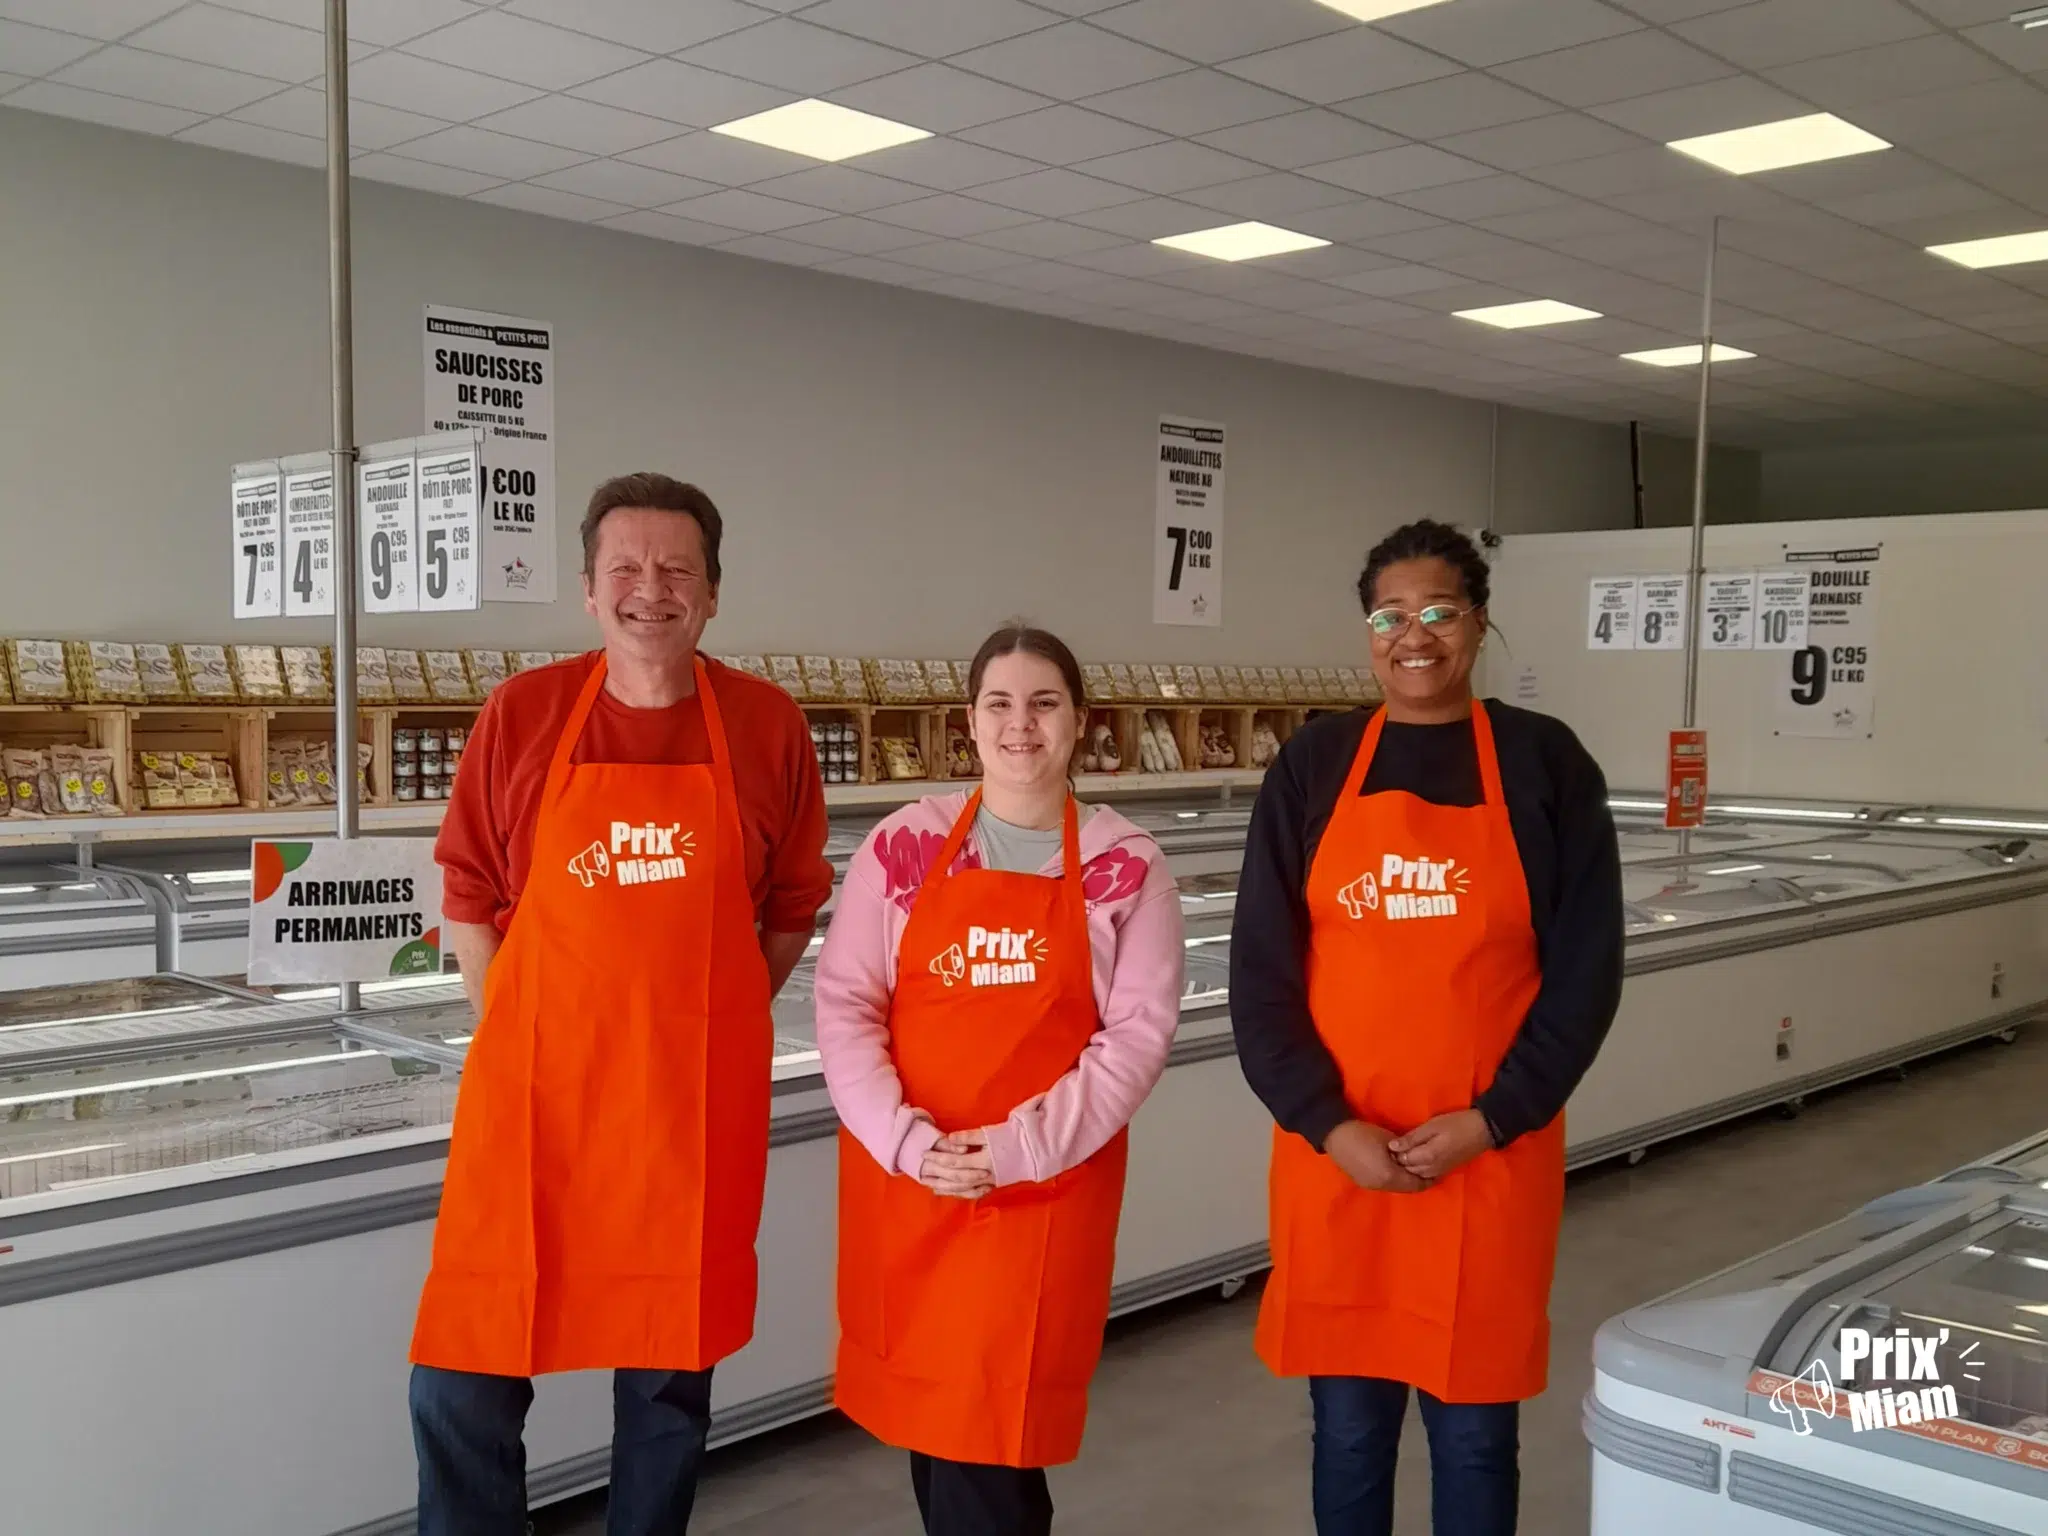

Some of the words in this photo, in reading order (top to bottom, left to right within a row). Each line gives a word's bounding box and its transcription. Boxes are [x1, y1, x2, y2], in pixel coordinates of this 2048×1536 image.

[430, 320, 444, 331] Les
[445, 322, 487, 338] essentiels
[487, 326, 493, 338] à
[496, 331, 526, 344] PETITS
[527, 334, 548, 345] PRIX
[435, 348, 543, 385] SAUCISSES
[458, 383, 477, 404] DE
[481, 386, 523, 409] PORC
[434, 420, 444, 431] 40
[445, 422, 450, 431] x
[494, 427, 521, 438] Origine
[522, 429, 547, 441] France
[457, 410, 497, 424] CAISSETTE
[498, 414, 506, 425] DE
[508, 416, 513, 425] 5
[514, 416, 524, 426] KG
[1161, 444, 1222, 470] ANDOUILLETTES
[422, 479, 440, 500] RÔTI
[441, 479, 450, 496] DE
[451, 477, 472, 495] PORC
[492, 468, 536, 497] €00
[1169, 469, 1200, 486] NATURE
[367, 482, 408, 503] ANDOUILLE
[252, 501, 260, 517] DE
[493, 501, 510, 521] LE
[514, 502, 535, 523] KG
[370, 531, 392, 600] 9
[392, 550, 398, 563] LE
[398, 550, 407, 562] KG
[426, 529, 448, 599] 5
[453, 549, 459, 561] LE
[460, 547, 469, 560] KG
[1167, 526, 1187, 591] 7
[1189, 552, 1198, 567] LE
[1199, 553, 1211, 569] KG
[243, 544, 258, 606] 7
[293, 540, 313, 603] 4
[1594, 612, 1613, 643] 4
[1644, 611, 1662, 644] 8
[1712, 614, 1728, 643] 3
[1761, 609, 1788, 644] 10
[1791, 645, 1828, 706] 9
[1832, 668, 1845, 682] LE
[1847, 668, 1865, 683] KG
[611, 821, 680, 855] Prix'
[616, 857, 686, 886] Miam
[1381, 853, 1455, 891] Prix'
[287, 878, 414, 907] ARRIVAGES
[1385, 893, 1457, 920] Miam
[275, 912, 422, 943] PERMANENTS
[967, 926, 1034, 960] Prix'
[971, 961, 1036, 987] Miam
[1940, 1428, 1988, 1446] PLAN
